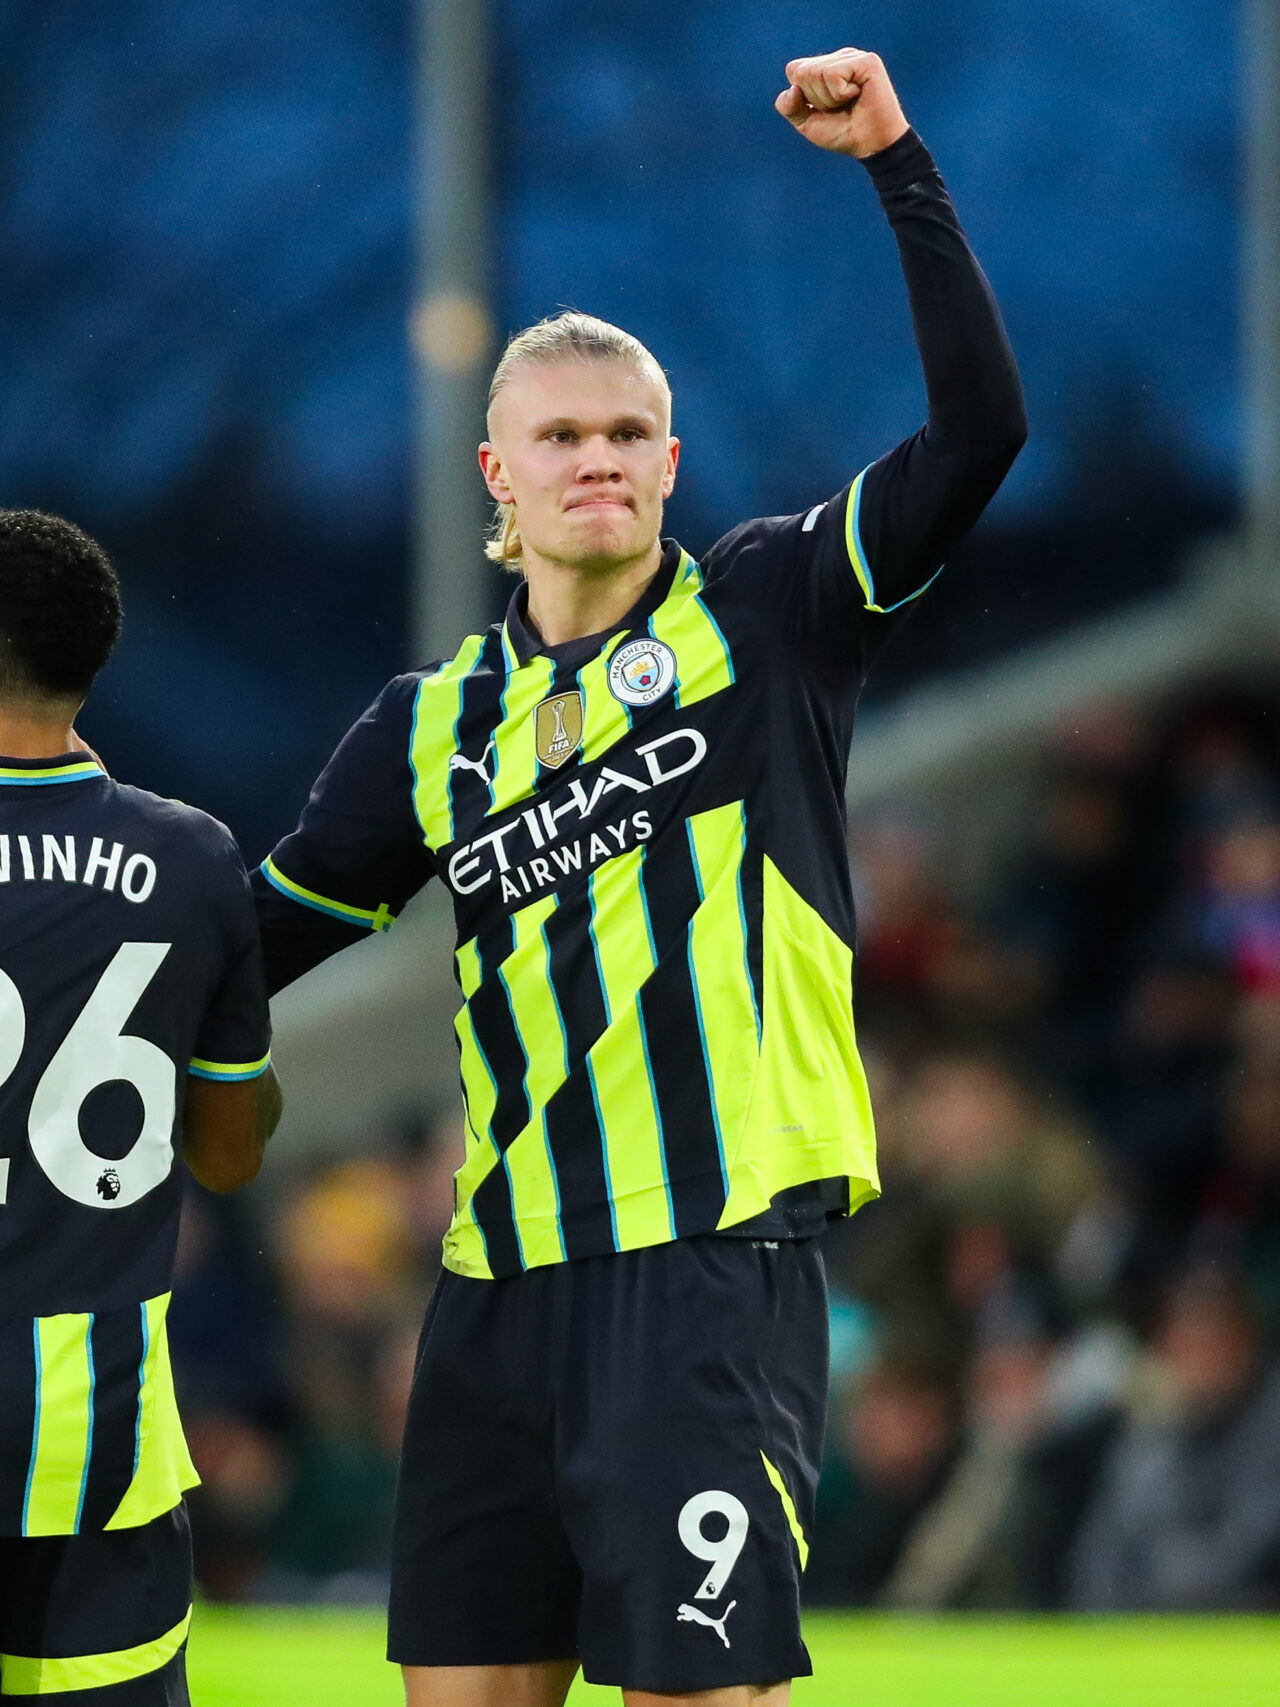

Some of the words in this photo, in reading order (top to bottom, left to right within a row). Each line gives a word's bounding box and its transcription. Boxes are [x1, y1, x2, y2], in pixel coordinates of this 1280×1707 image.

[613, 643, 663, 679] MANCHESTER
[642, 687, 661, 702] CITY
[548, 739, 570, 754] FIFA
[448, 728, 707, 896] ETIHAD
[500, 810, 653, 904] AIRWAYS
[677, 1490, 750, 1600] 9
